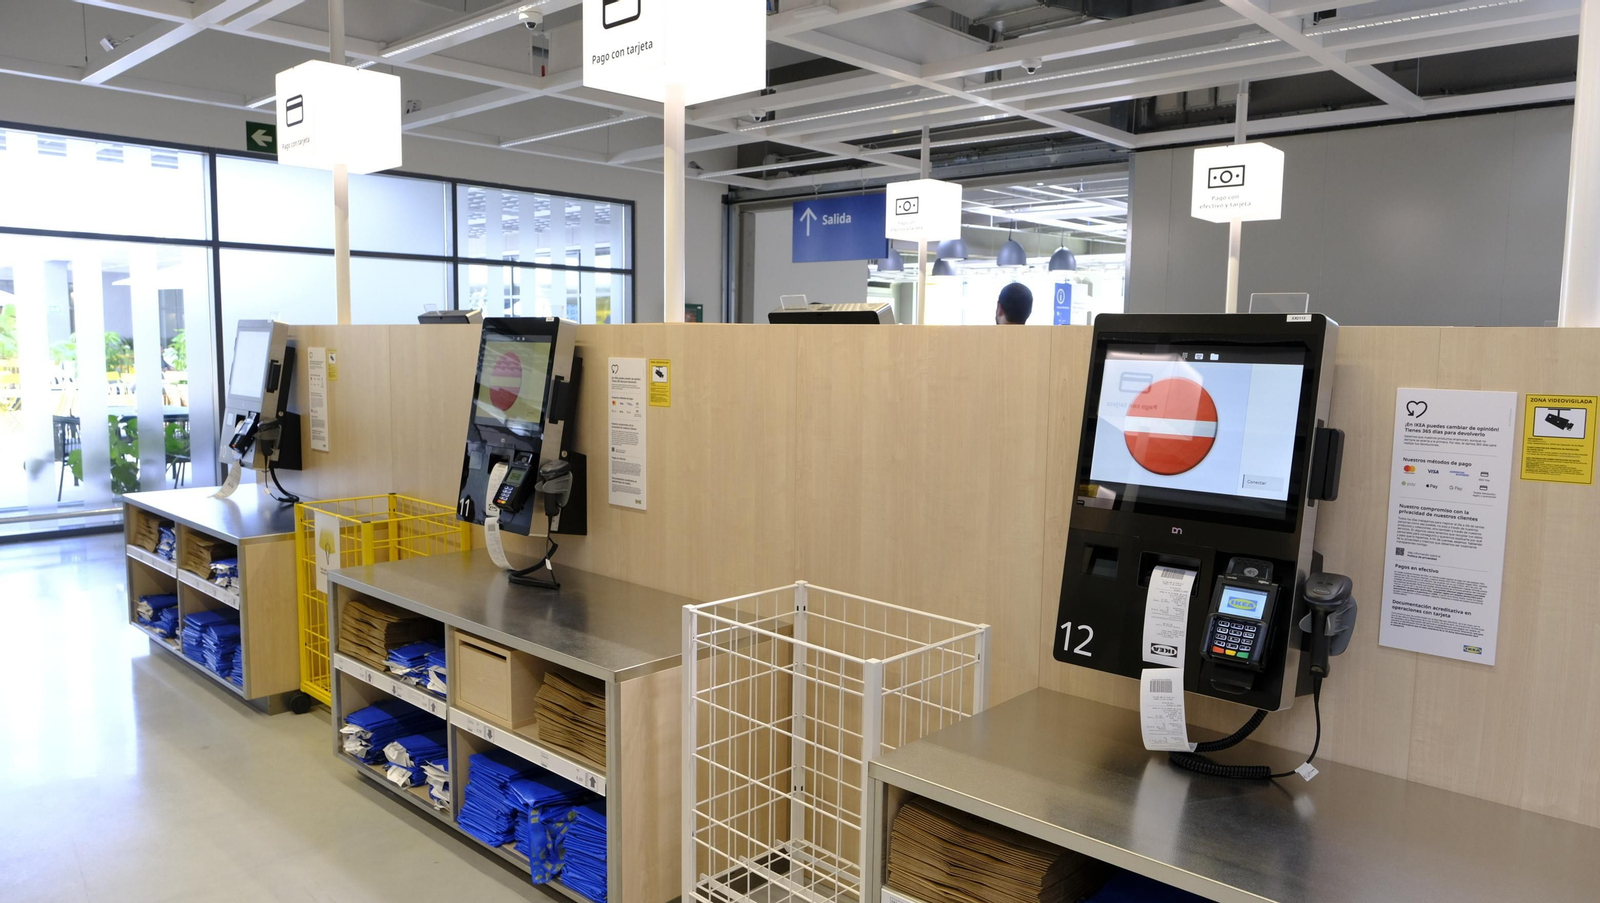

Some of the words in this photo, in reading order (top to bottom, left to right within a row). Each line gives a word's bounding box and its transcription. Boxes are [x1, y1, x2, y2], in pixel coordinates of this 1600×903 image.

[592, 53, 610, 65] Pago
[611, 48, 625, 59] con
[626, 40, 653, 55] tarjeta
[282, 143, 290, 151] Pago
[822, 212, 852, 225] Salida
[460, 498, 470, 517] 11
[1399, 509, 1425, 517] privacidad
[1230, 599, 1255, 608] IKEA
[1392, 599, 1431, 610] Documentación
[1432, 606, 1464, 615] acreditativa
[1392, 605, 1422, 614] operaciones
[1060, 621, 1094, 657] 12
